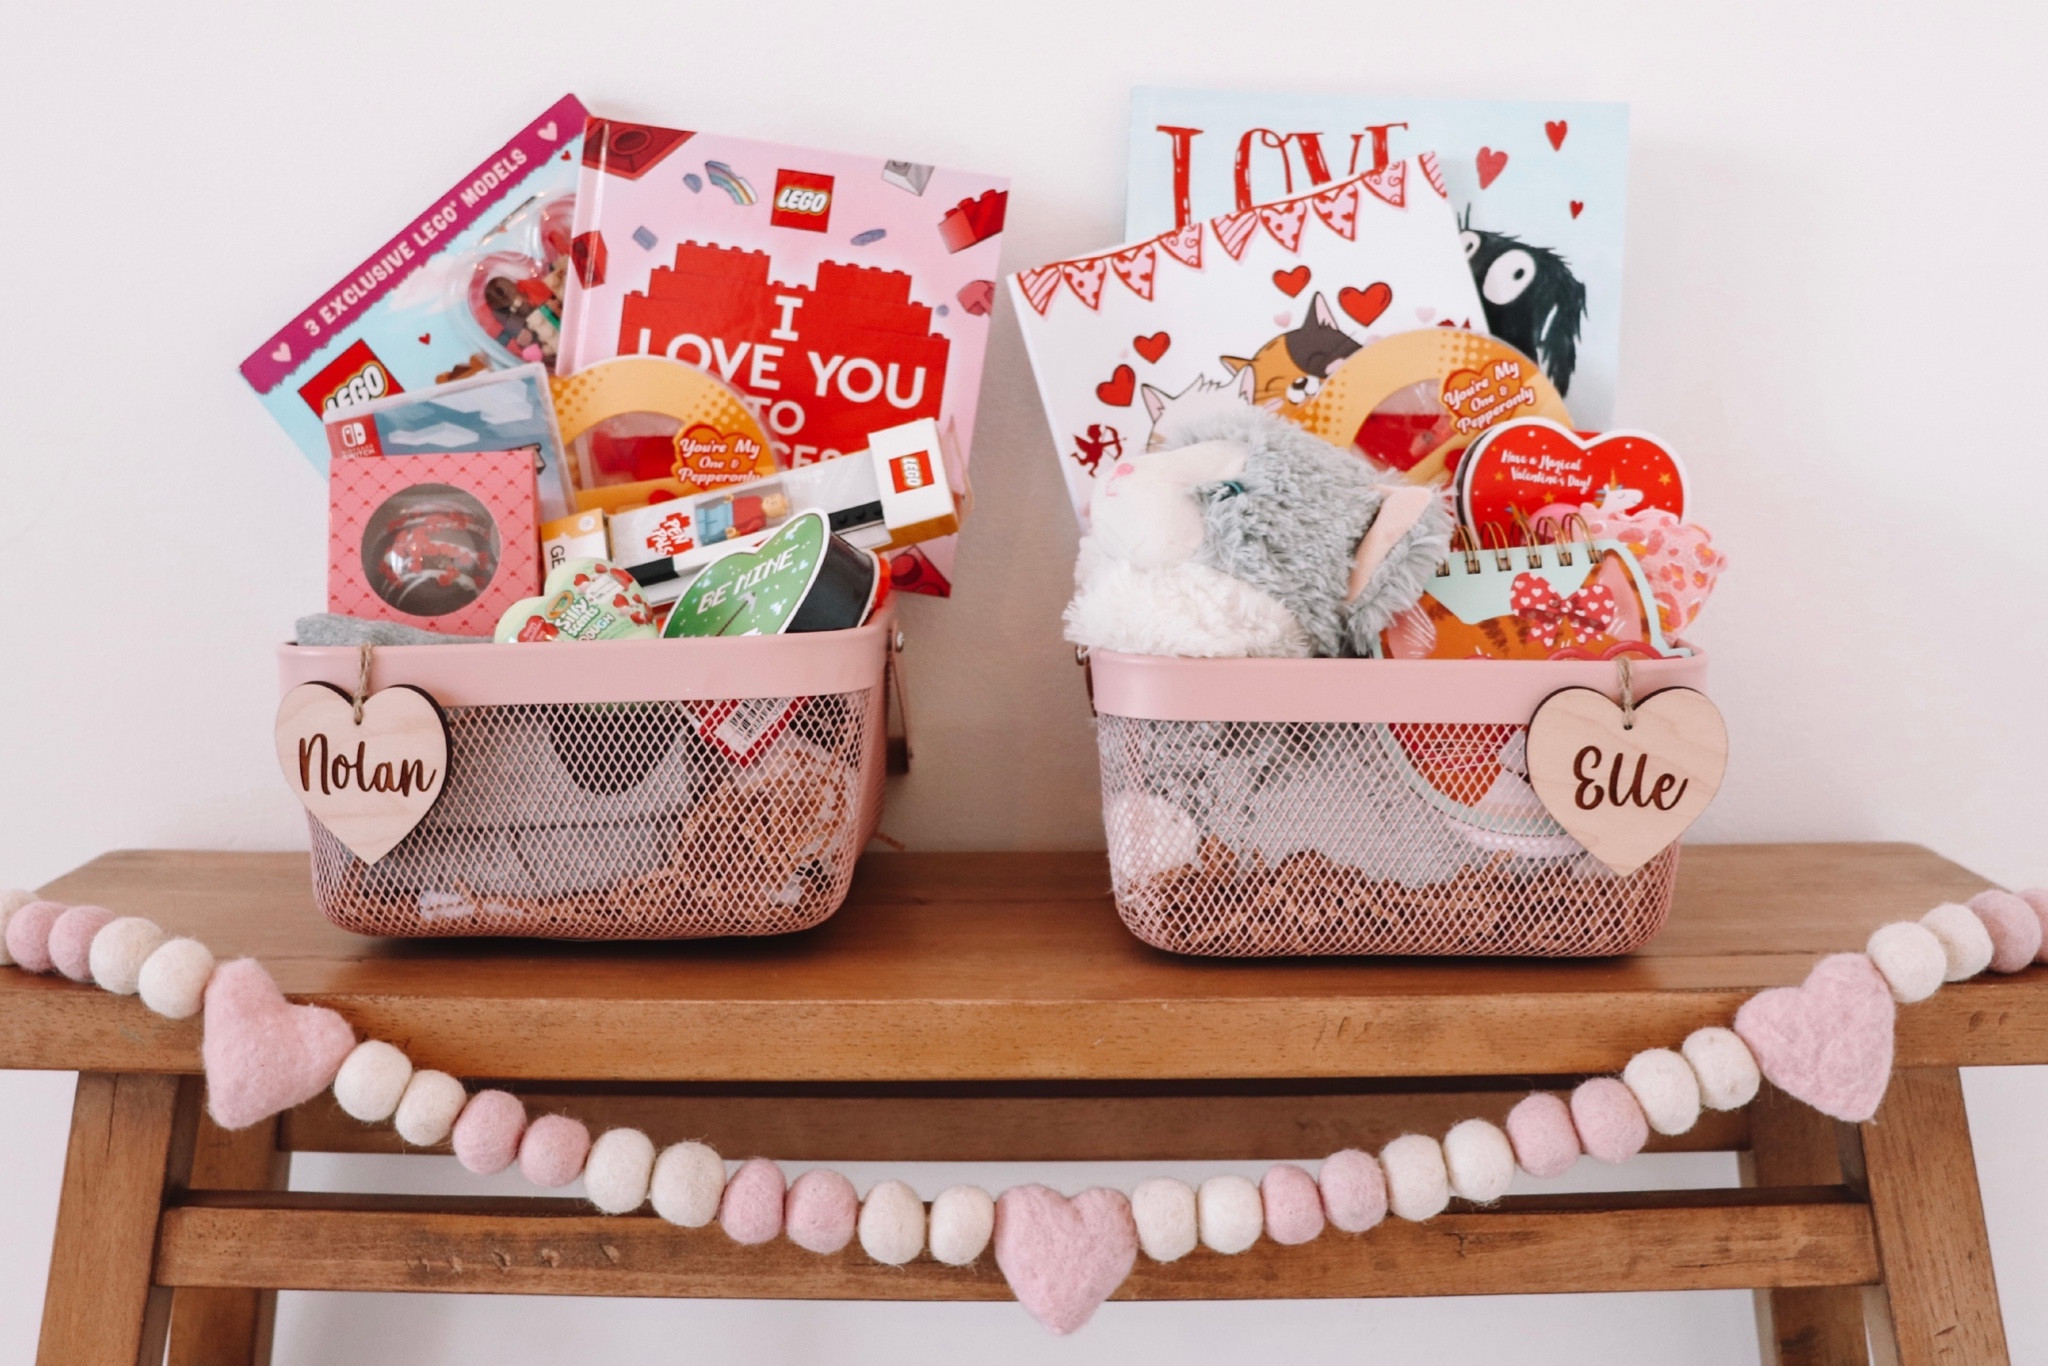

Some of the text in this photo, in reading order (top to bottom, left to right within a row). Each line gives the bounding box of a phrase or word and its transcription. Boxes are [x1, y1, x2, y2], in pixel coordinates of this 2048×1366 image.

[777, 188, 828, 214] LEGO
[304, 318, 321, 337] 3
[319, 241, 415, 325] EXCLUSIVE
[460, 149, 527, 208] MODELS
[771, 295, 804, 342] I
[808, 351, 927, 409] YOU
[1444, 361, 1519, 410] You're My
[744, 394, 806, 436] TO
[1456, 387, 1535, 434] Pepperonly
[1470, 395, 1495, 412] One
[680, 438, 728, 458] You're
[734, 438, 761, 460] My
[698, 456, 725, 470] One
[1538, 455, 1582, 476] Magical
[678, 467, 761, 485] Pepperonly
[901, 456, 923, 488] LEGO
[1567, 474, 1593, 495] Day!
[651, 528, 675, 556] PALS
[663, 518, 690, 545] PEN
[697, 543, 799, 614] BE MINE
[555, 597, 590, 632] Silly
[567, 606, 600, 639] scents
[299, 732, 436, 795] Nolan
[1572, 745, 1689, 811] Elle
